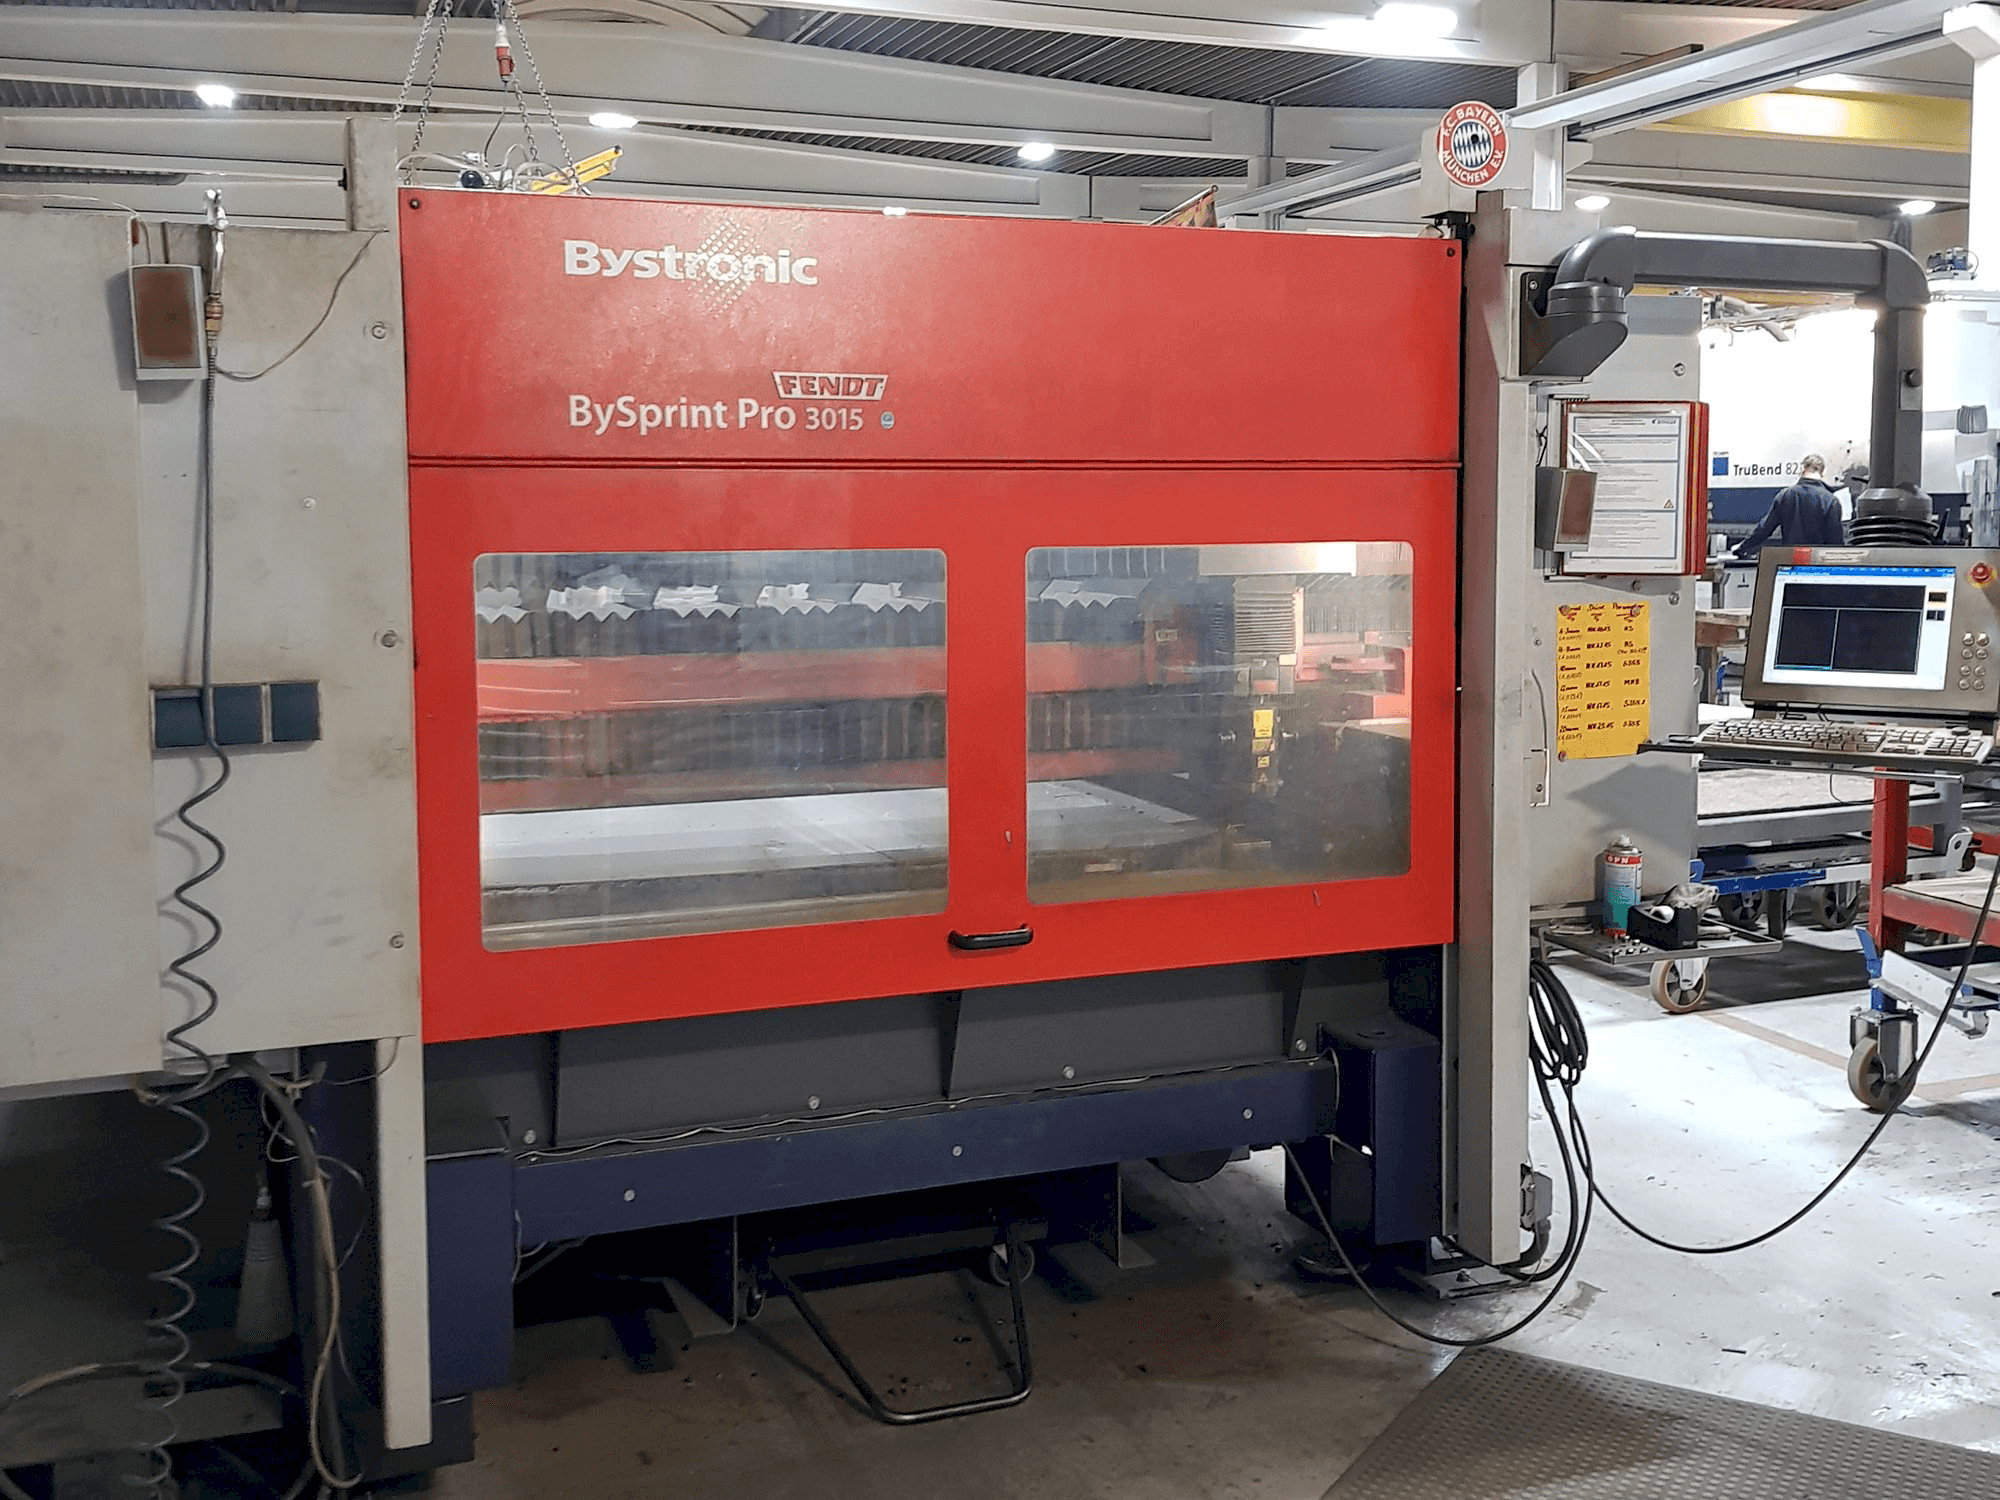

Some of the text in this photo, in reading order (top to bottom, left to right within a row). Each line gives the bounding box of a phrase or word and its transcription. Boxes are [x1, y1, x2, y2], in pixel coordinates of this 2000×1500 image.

[1456, 106, 1503, 136] BAYERN
[563, 240, 819, 285] Bystronic
[779, 375, 885, 397] FENDT
[568, 394, 864, 436] BySprint Pro 3015
[1733, 462, 1803, 476] TruBend 82
